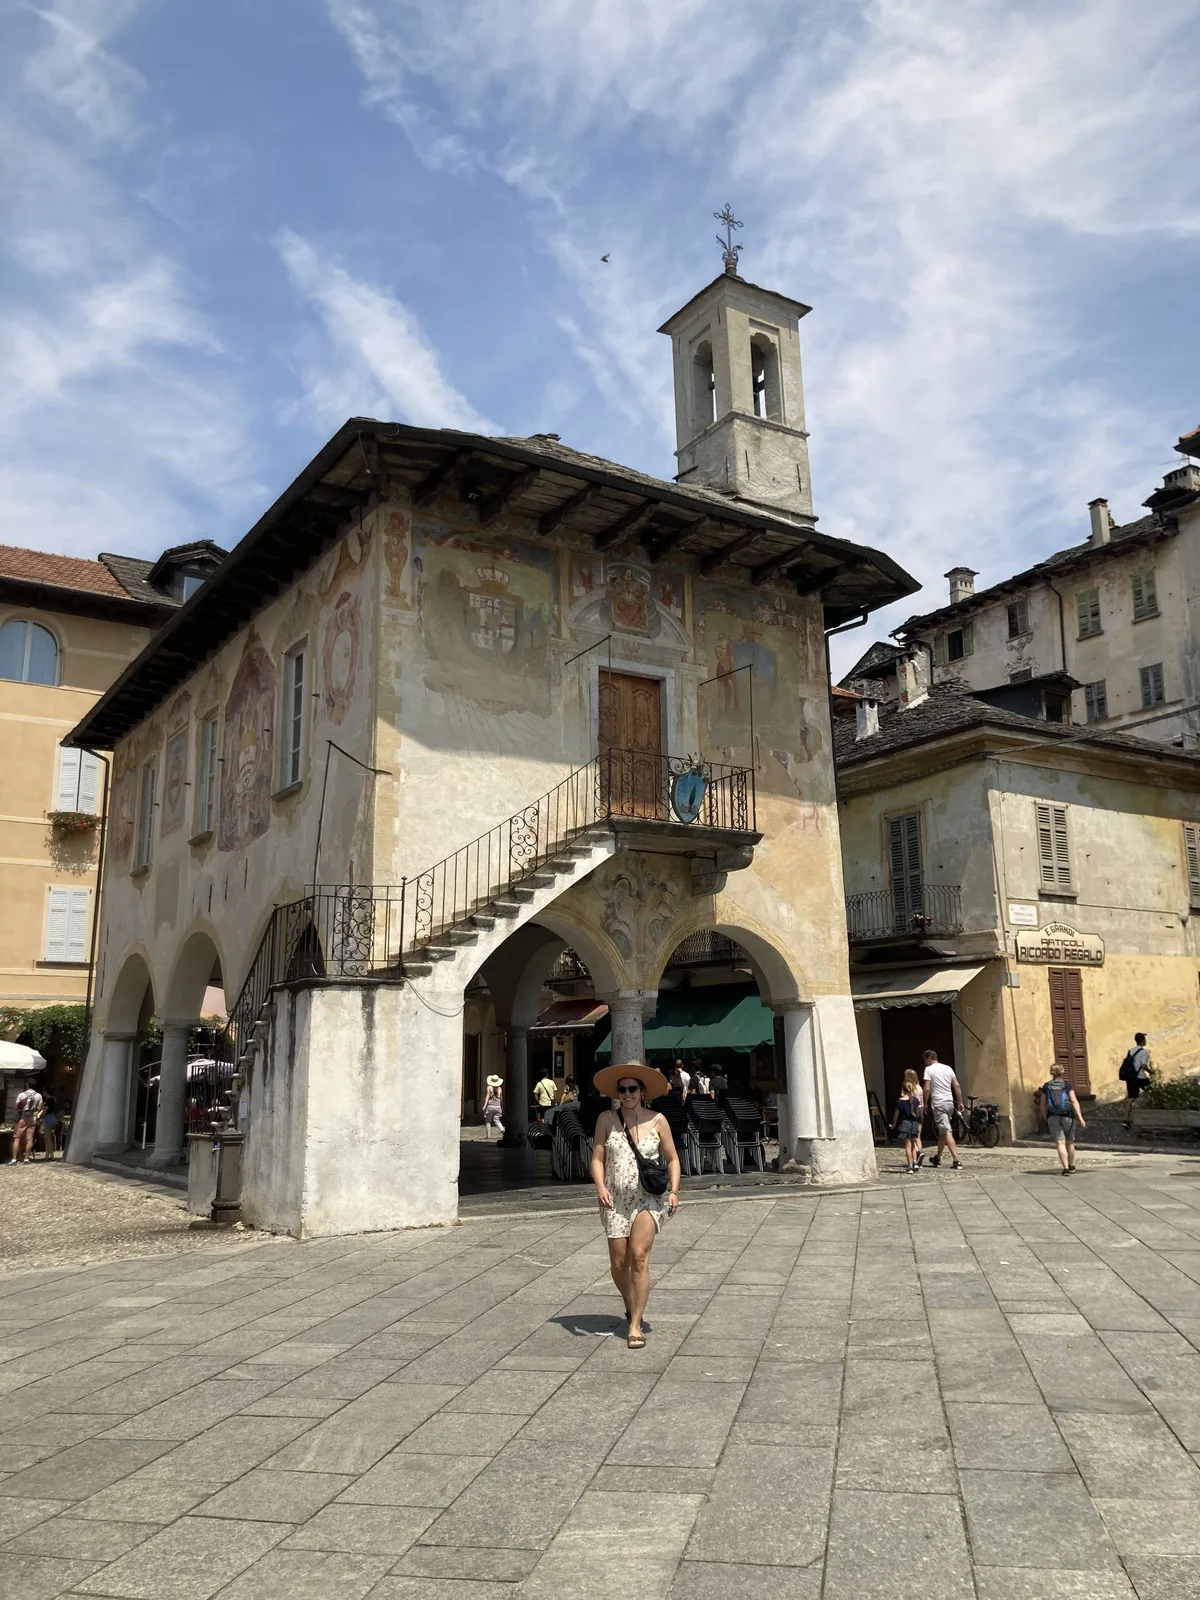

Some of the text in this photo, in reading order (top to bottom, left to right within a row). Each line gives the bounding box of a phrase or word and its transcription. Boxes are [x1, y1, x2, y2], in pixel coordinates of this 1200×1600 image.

[1050, 925, 1075, 937] GRANDI
[1041, 939, 1084, 947] ARTICOLI
[1020, 947, 1102, 961] RICORDO REGALO
